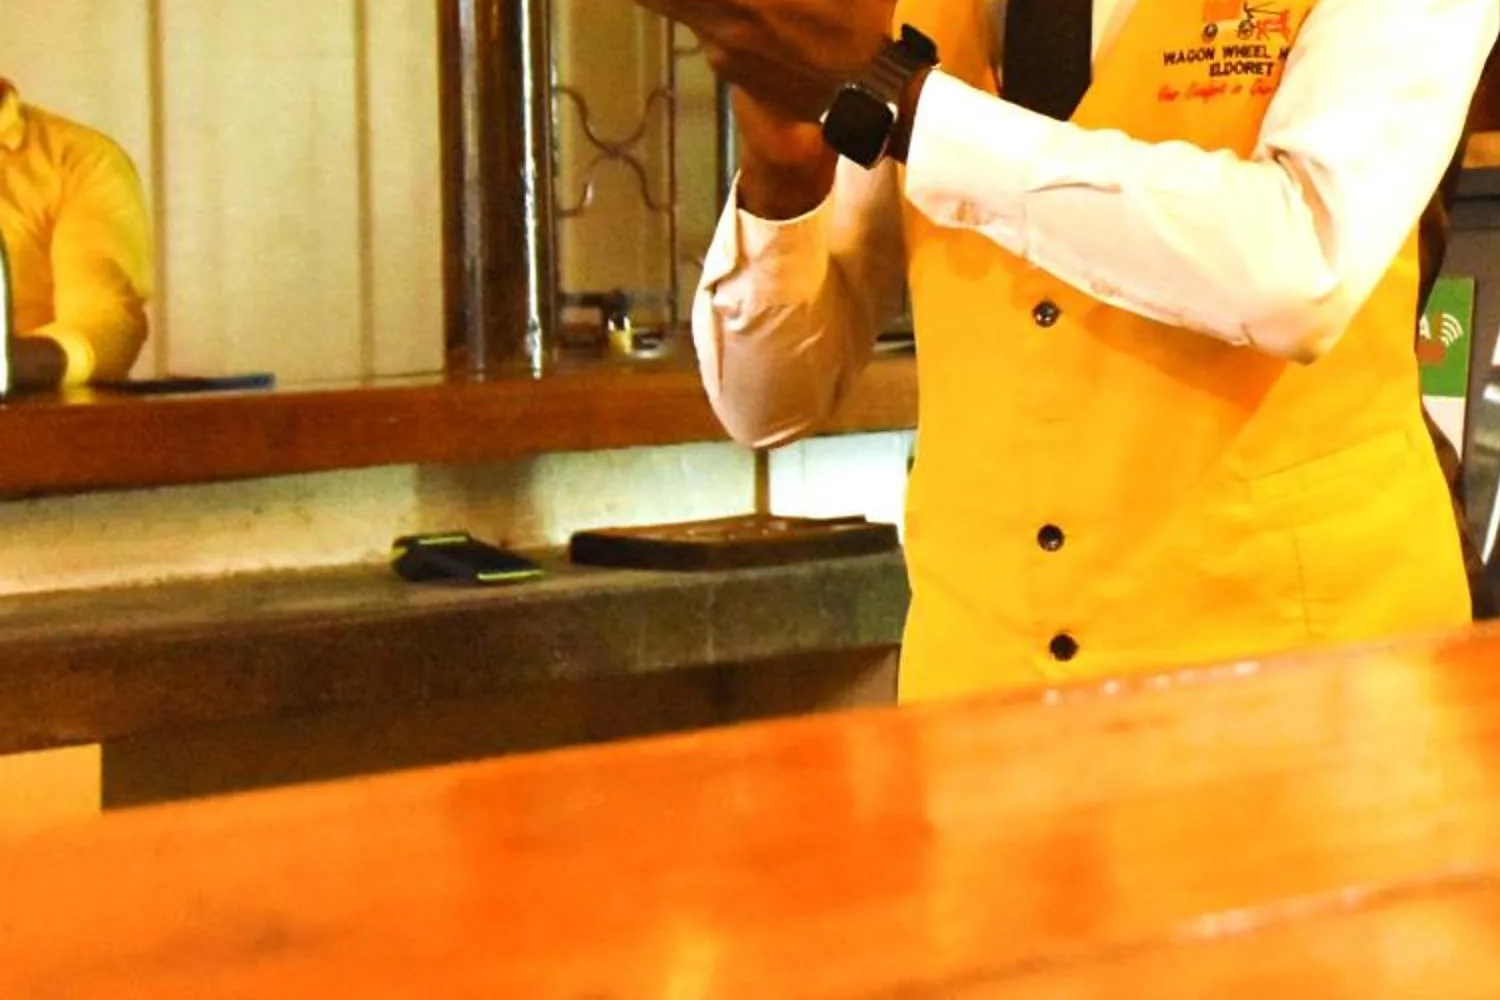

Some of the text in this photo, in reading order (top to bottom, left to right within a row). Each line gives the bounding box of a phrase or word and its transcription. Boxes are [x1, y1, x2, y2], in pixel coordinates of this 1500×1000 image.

[1163, 47, 1215, 66] WAGON
[1222, 44, 1271, 60] WHEEL
[1208, 60, 1274, 77] ELDORET
